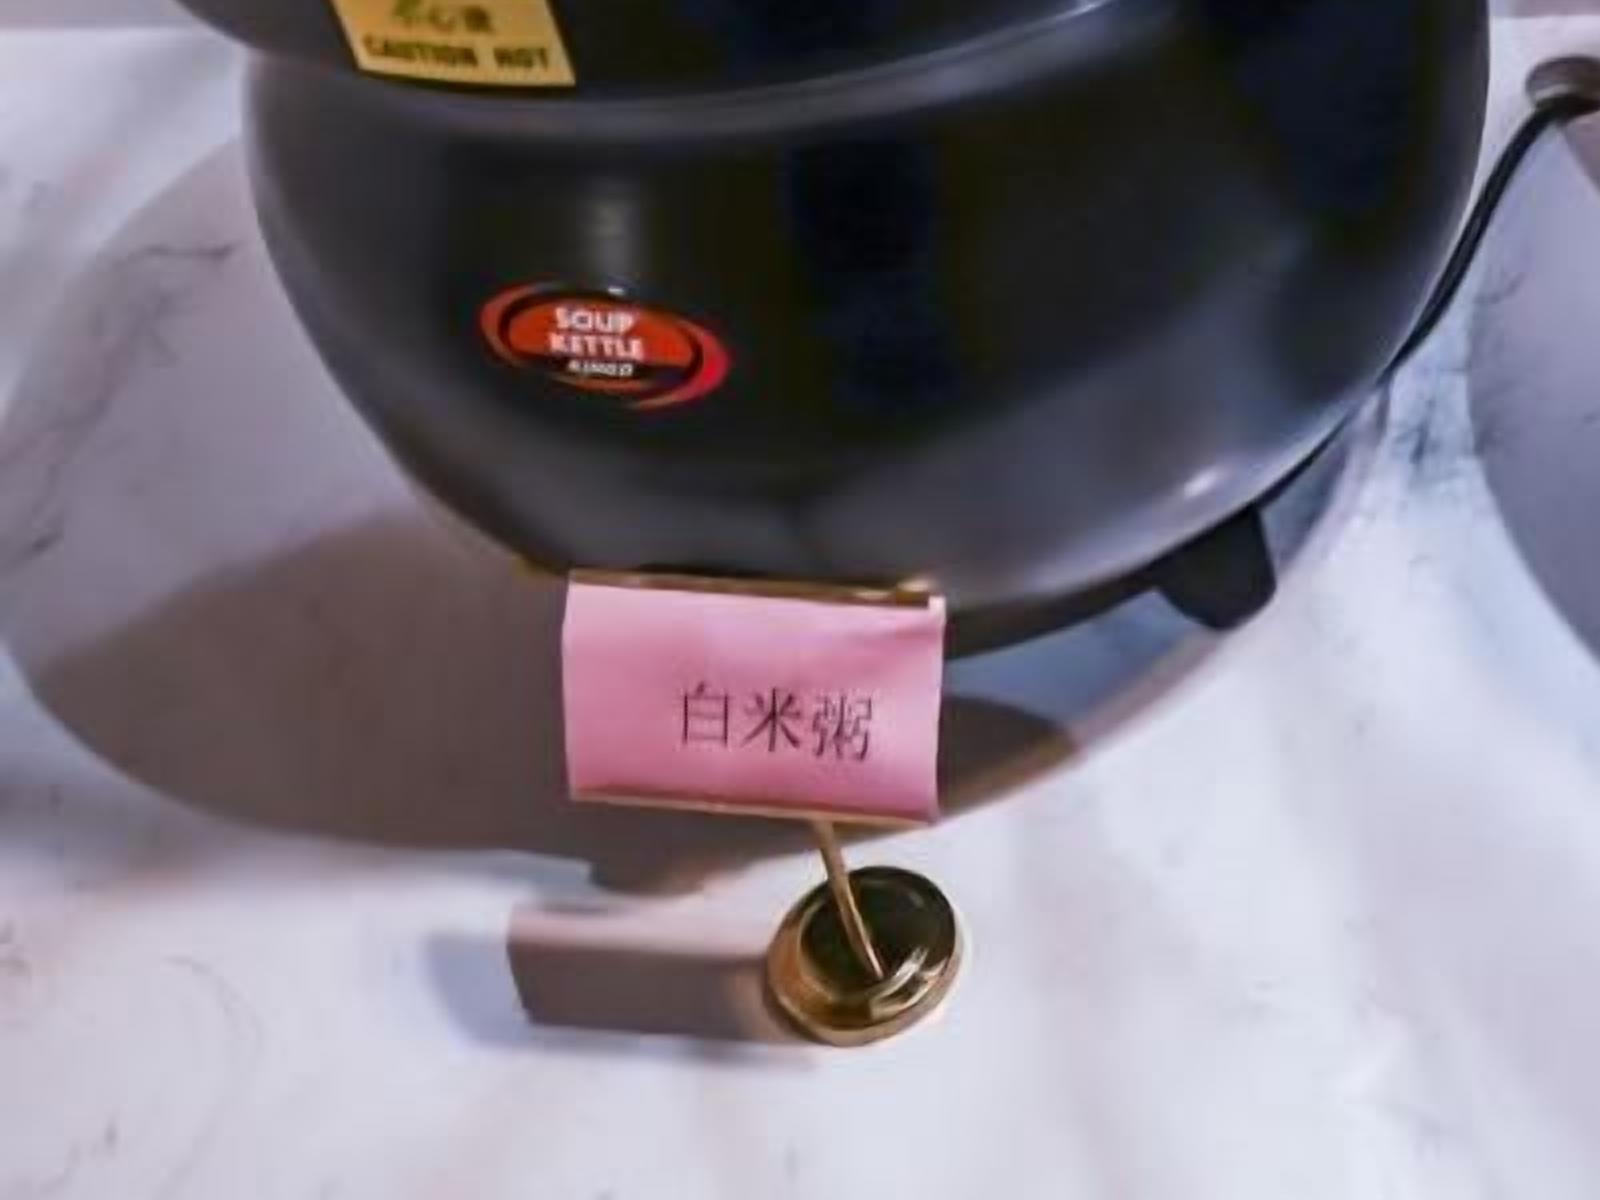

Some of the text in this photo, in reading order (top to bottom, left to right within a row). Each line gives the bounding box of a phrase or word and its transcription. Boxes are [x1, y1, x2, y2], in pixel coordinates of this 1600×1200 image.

[363, 35, 551, 69] CAUTION HOT
[554, 306, 636, 334] SOUP
[549, 332, 644, 361] KETTLE
[681, 681, 872, 762] 白米粥
